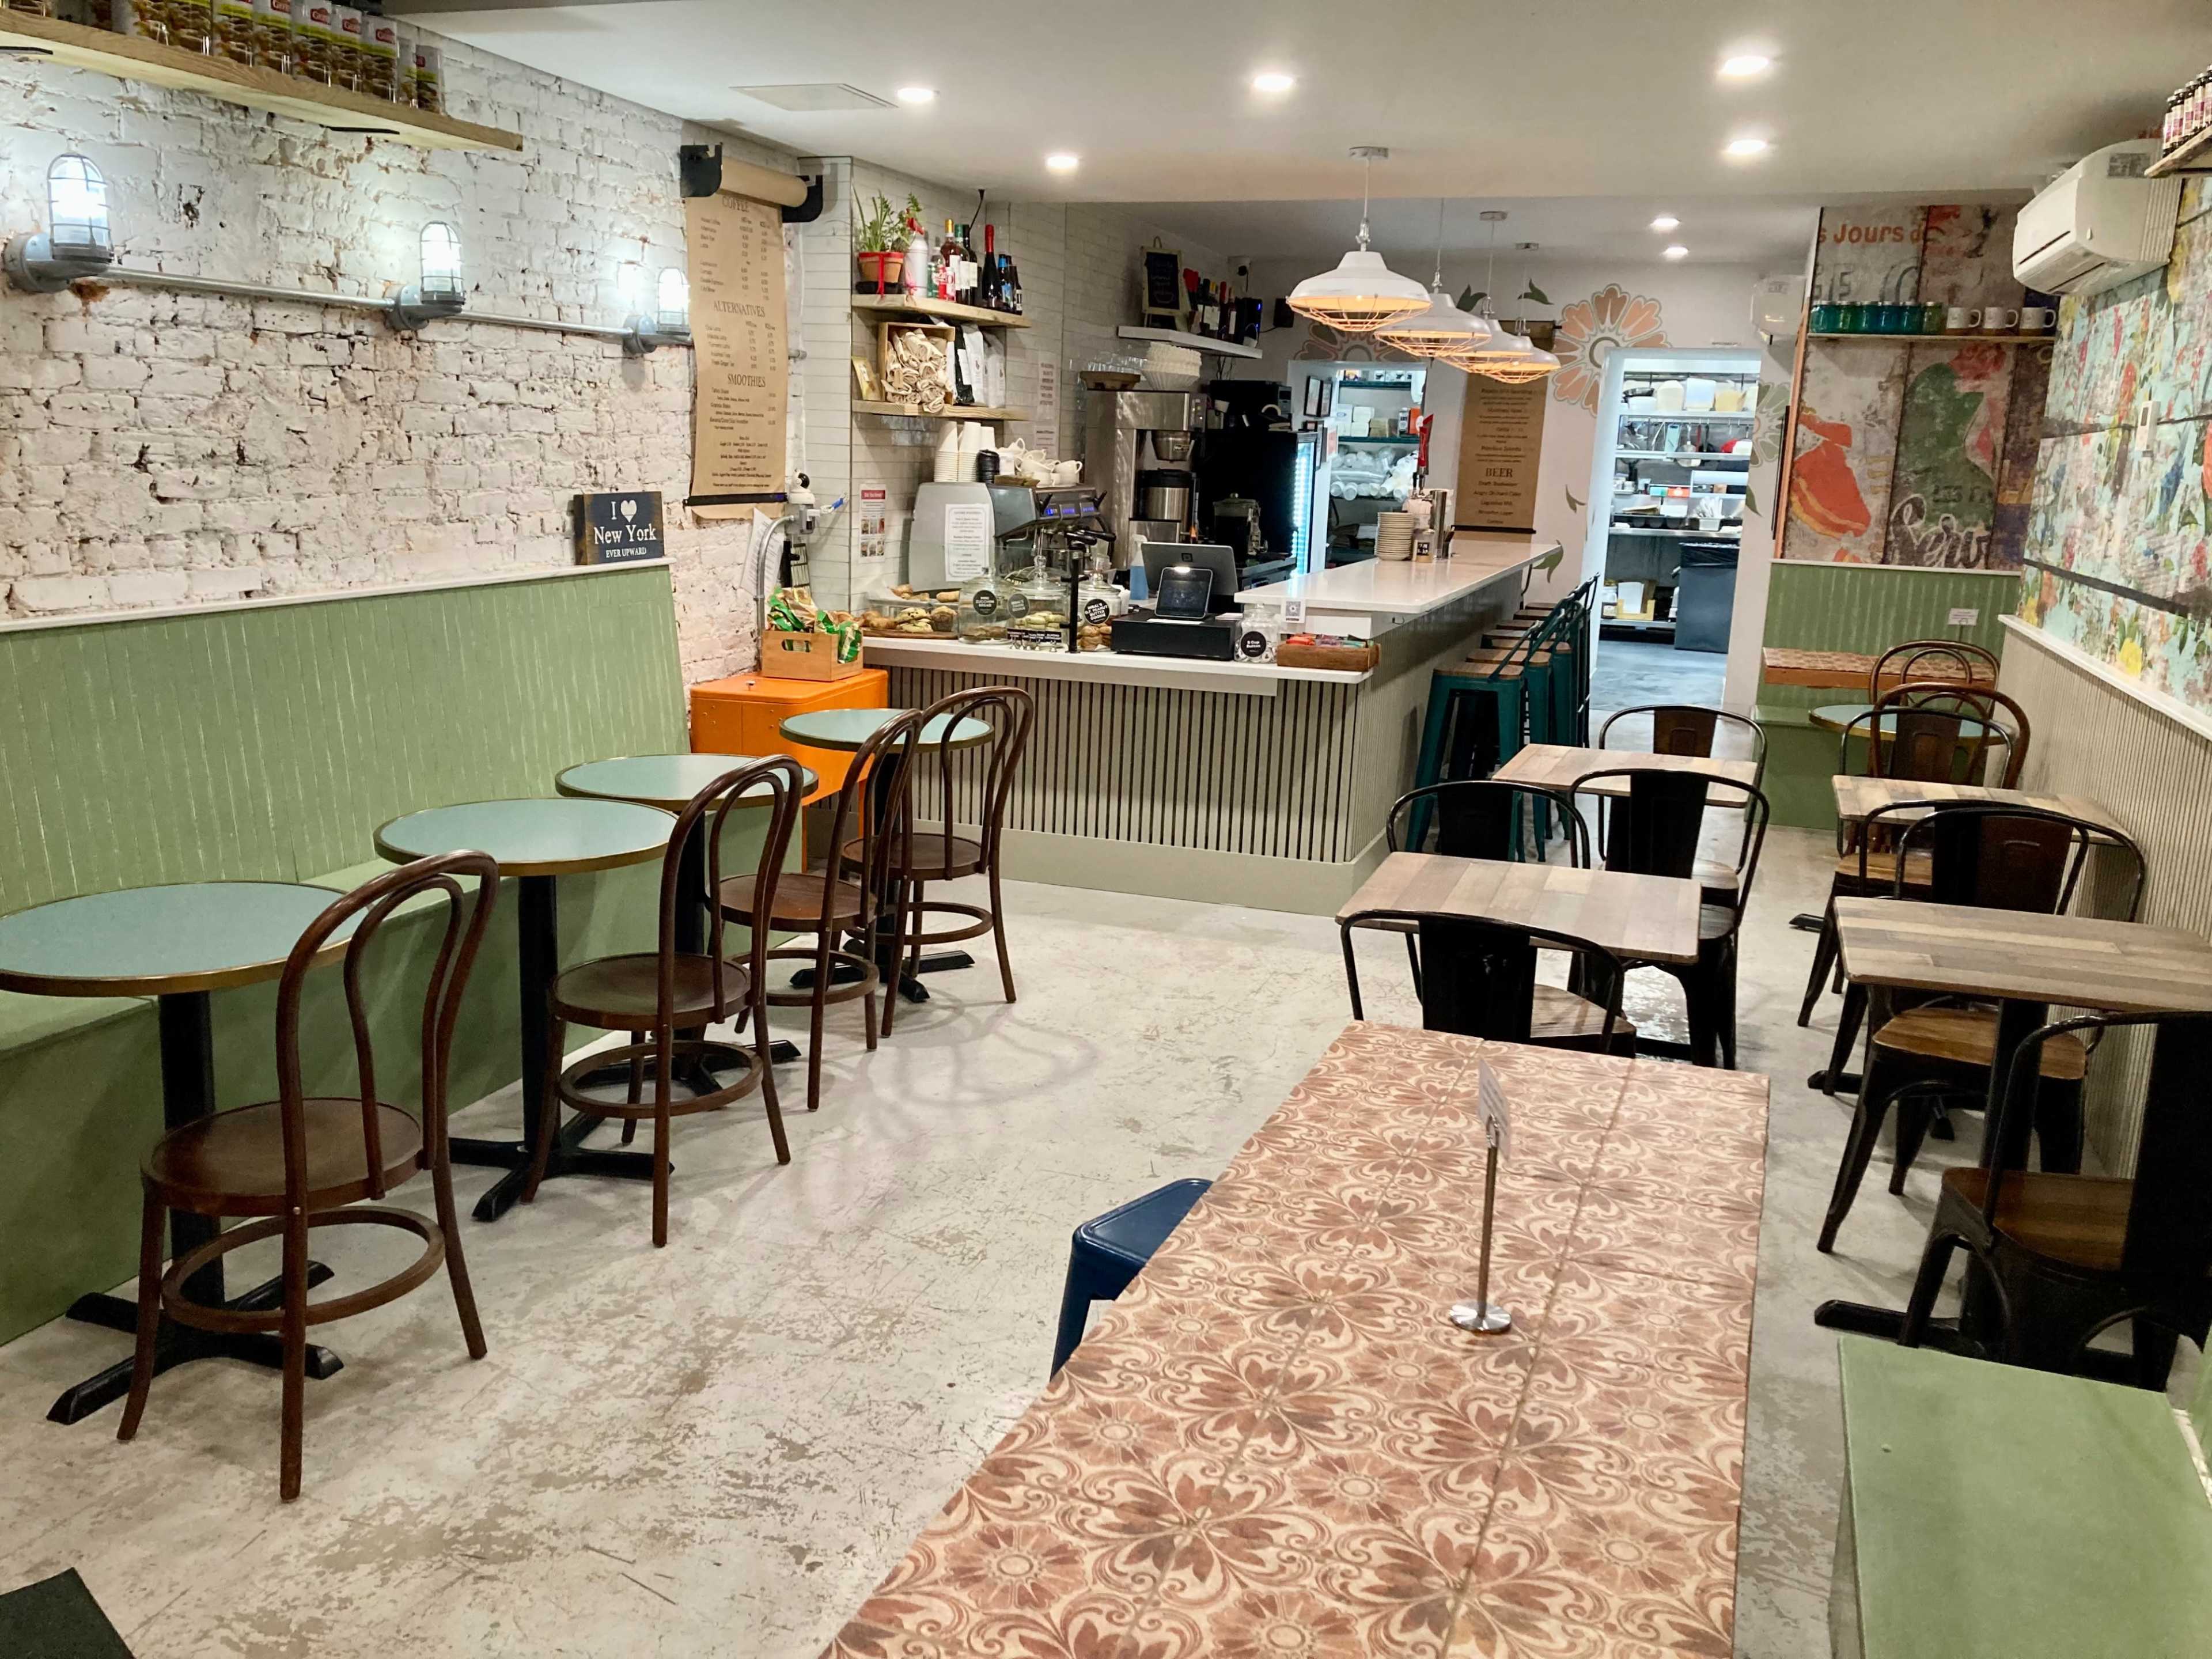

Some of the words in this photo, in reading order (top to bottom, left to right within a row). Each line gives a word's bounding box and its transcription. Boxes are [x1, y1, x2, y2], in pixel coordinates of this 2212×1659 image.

[722, 196, 749, 213] COFFEE
[1834, 224, 1904, 244] Jours
[714, 301, 766, 317] ALTERNATIVES
[728, 374, 766, 387] SMOOTHIES
[1486, 468, 1513, 478] BEER
[611, 501, 617, 520] I
[594, 527, 622, 544] New
[626, 523, 657, 541] York
[606, 549, 621, 558] EVER
[622, 547, 646, 556] UPWARD
